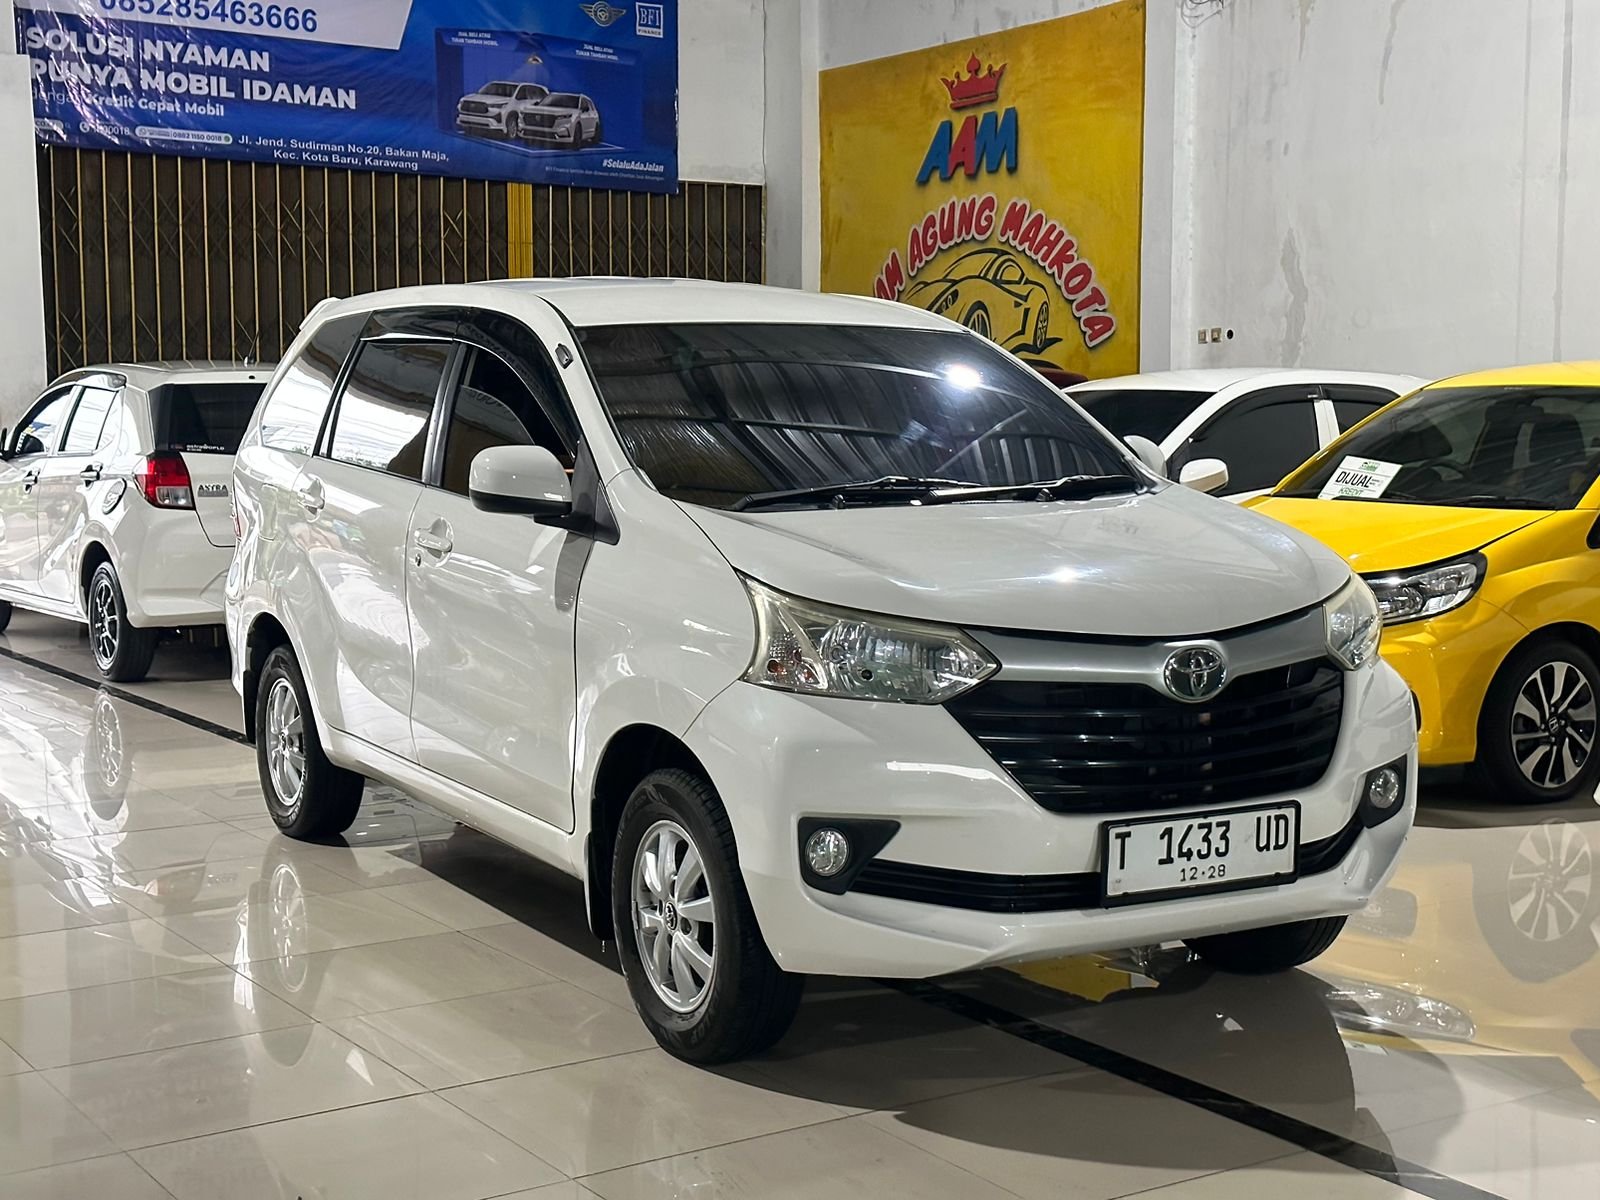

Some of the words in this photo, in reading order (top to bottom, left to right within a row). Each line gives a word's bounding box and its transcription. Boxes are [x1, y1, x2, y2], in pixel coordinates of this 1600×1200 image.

[640, 8, 660, 26] BFI
[26, 26, 134, 62] SOLUSI
[143, 39, 270, 72] NYAMAN
[31, 58, 132, 90] PUNYA
[140, 69, 235, 99] MOBIL
[243, 79, 357, 110] IDAMAN
[138, 98, 181, 113] Cepat
[184, 102, 224, 117] Mobil
[255, 136, 287, 148] Jend.
[290, 139, 345, 153] Sudirman
[347, 144, 382, 157] No.20,
[385, 147, 419, 159] Bakan
[421, 150, 450, 163] Maja,
[914, 106, 1018, 185] AAM
[273, 149, 299, 161] Kec.
[302, 152, 329, 163] Kota
[332, 154, 362, 167] Baru,
[364, 157, 419, 172] Karawang
[602, 158, 664, 173] #SelaluAdaJalan
[907, 194, 998, 277] AGUNG
[999, 200, 1116, 350] MAHKOTA
[1335, 471, 1373, 488] DIJUAL
[1115, 831, 1131, 869] T
[1158, 820, 1230, 865] 1433
[1255, 814, 1289, 852] UD
